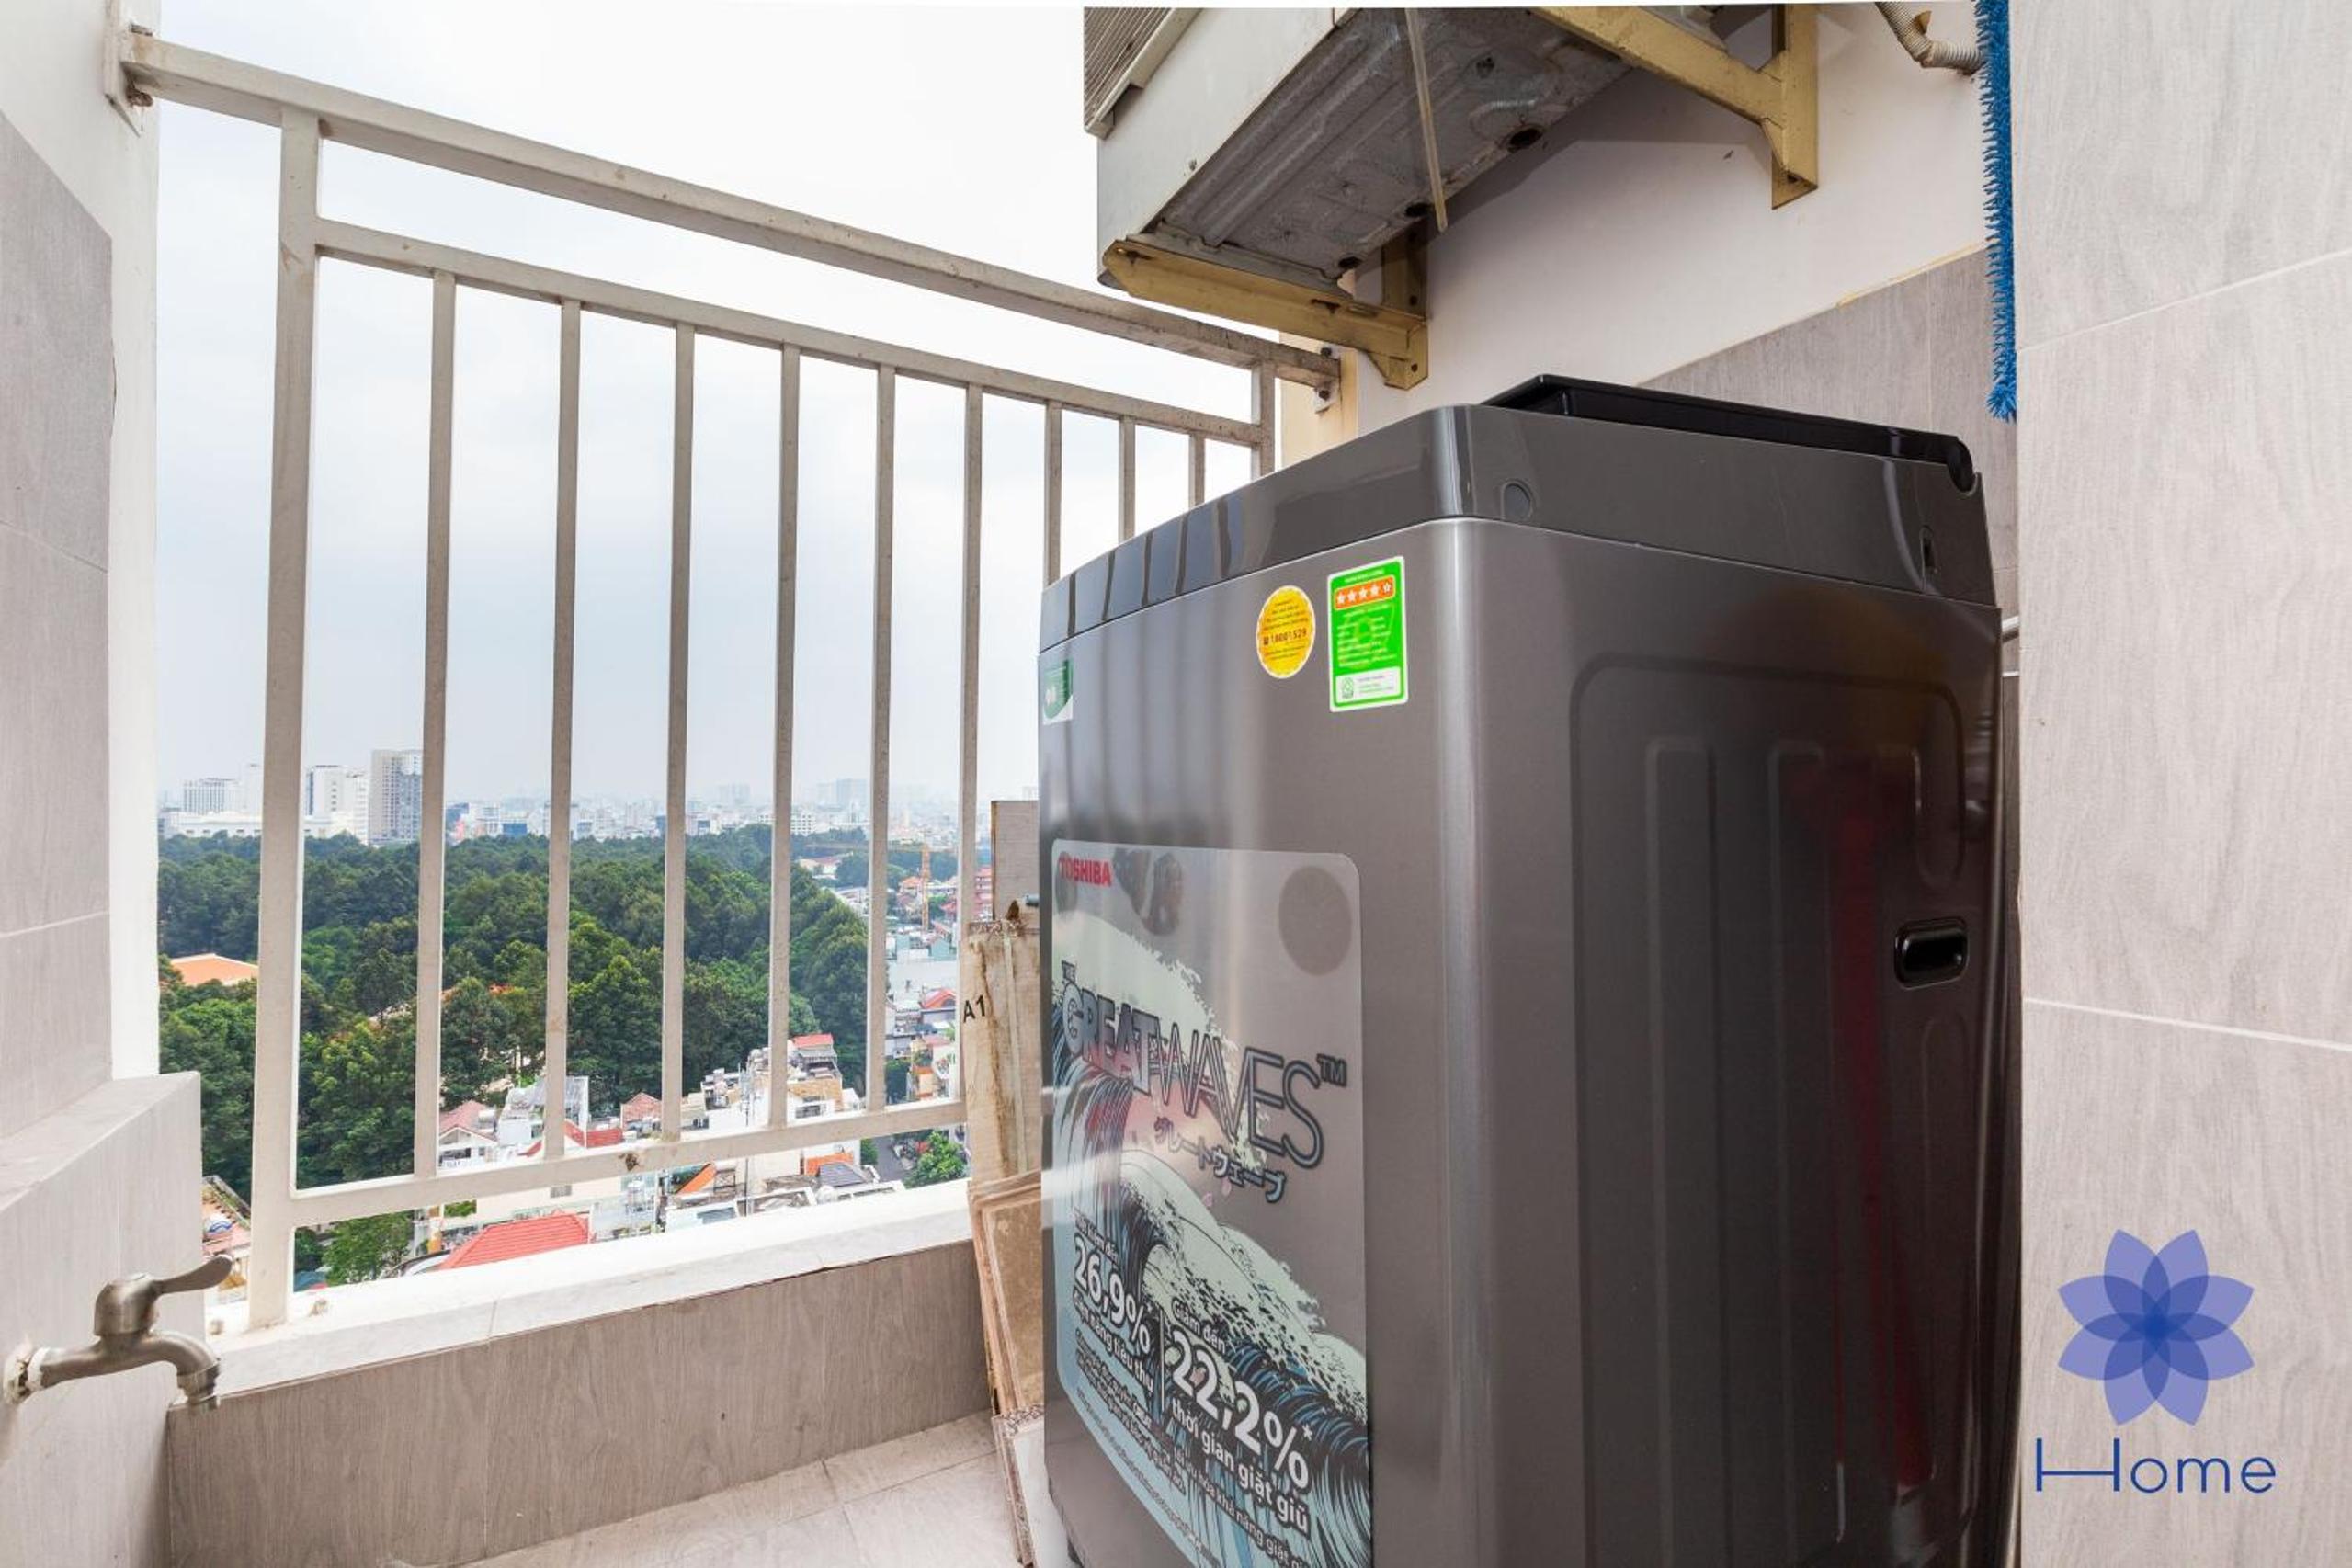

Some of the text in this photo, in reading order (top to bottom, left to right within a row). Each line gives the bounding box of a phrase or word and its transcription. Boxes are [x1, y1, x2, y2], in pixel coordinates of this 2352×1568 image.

[1059, 857, 1111, 887] TOSHIBA
[962, 995, 985, 1023] A1
[1062, 983, 1160, 1096] GREAT
[1203, 1324, 1225, 1355] đến
[1172, 1397, 1199, 1438] thời
[1201, 1431, 1234, 1471] gian
[1239, 1463, 1273, 1505] giặt
[1236, 1513, 1264, 1546] năng
